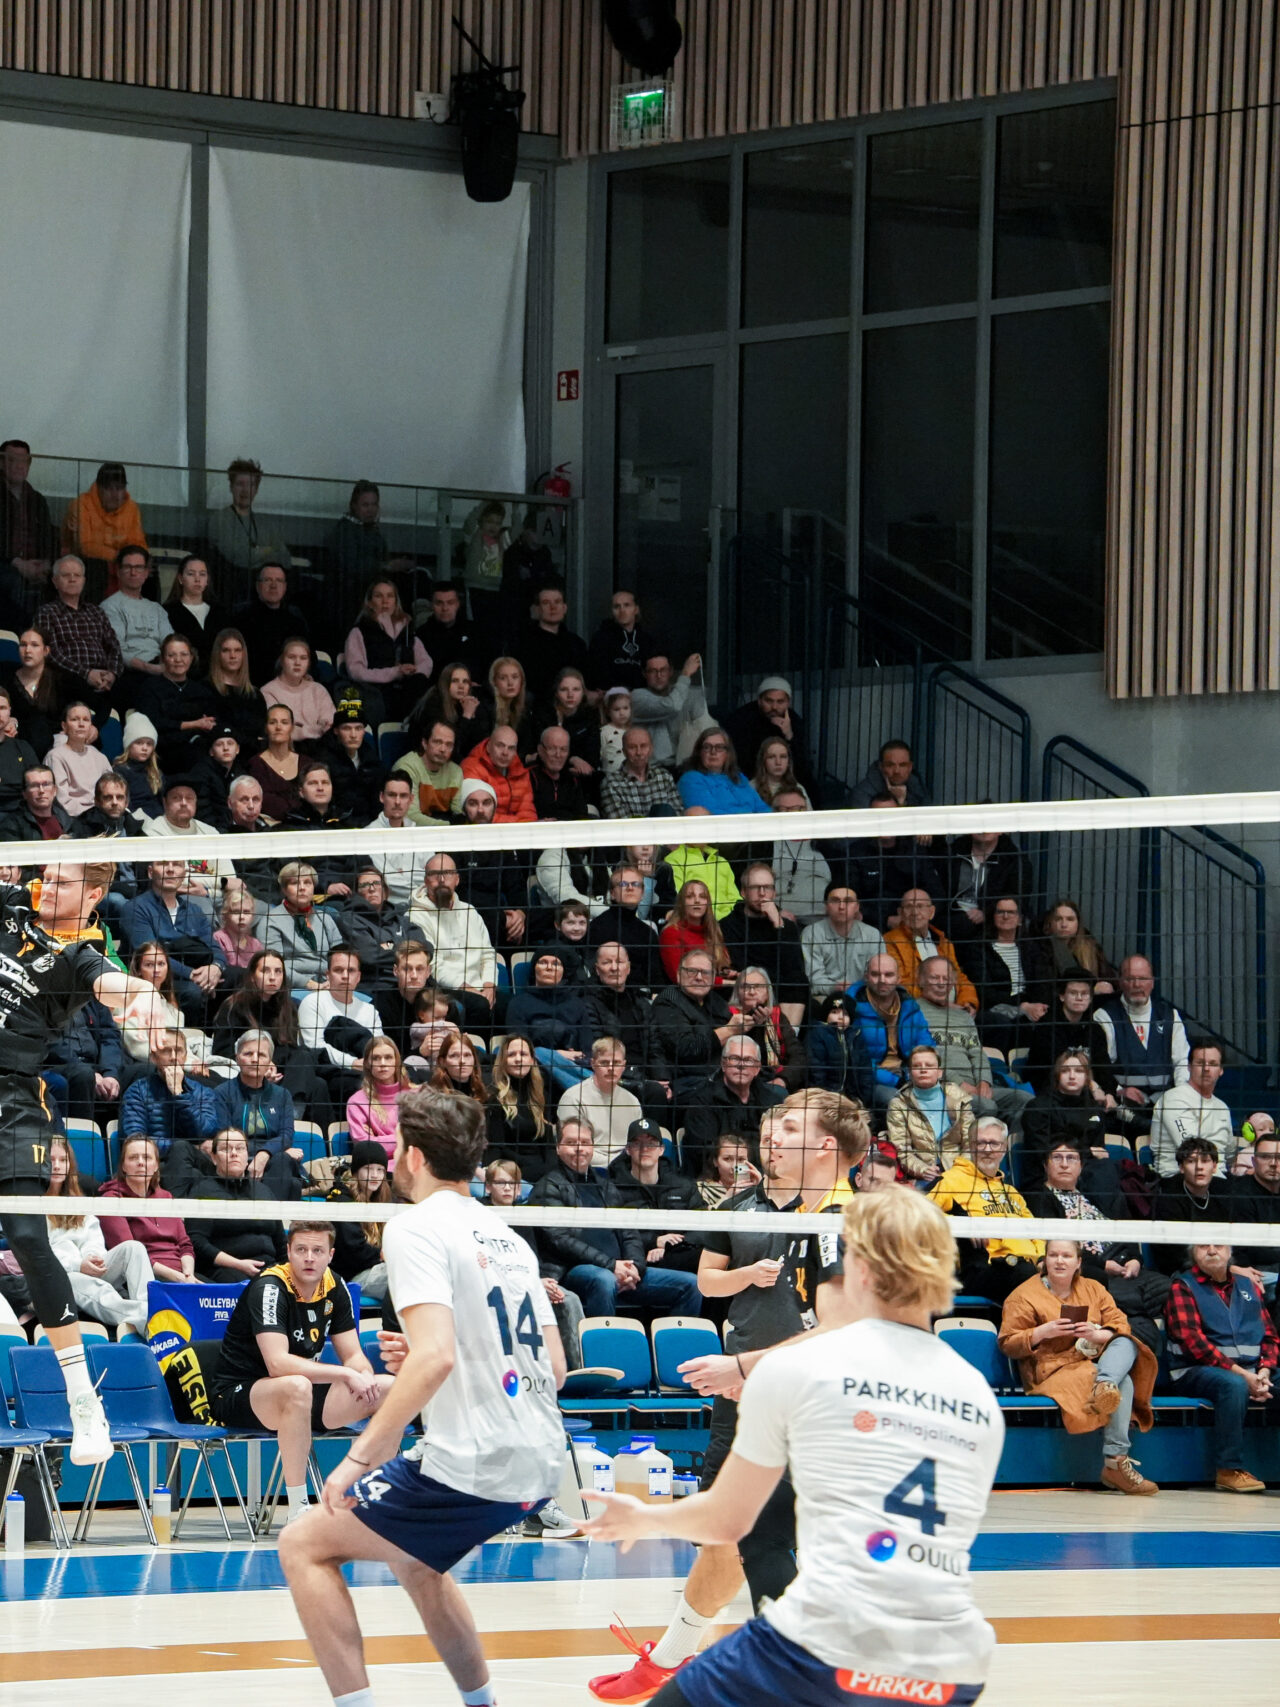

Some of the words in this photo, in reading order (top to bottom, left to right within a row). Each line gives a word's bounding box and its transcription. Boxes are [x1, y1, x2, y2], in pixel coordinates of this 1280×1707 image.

[32, 1144, 45, 1164] 17
[486, 1285, 544, 1361] 14
[842, 1377, 992, 1427] PARKKINEN
[881, 1416, 978, 1453] Pihlajalinna
[883, 1457, 947, 1537] 4
[907, 1543, 962, 1577] OULU
